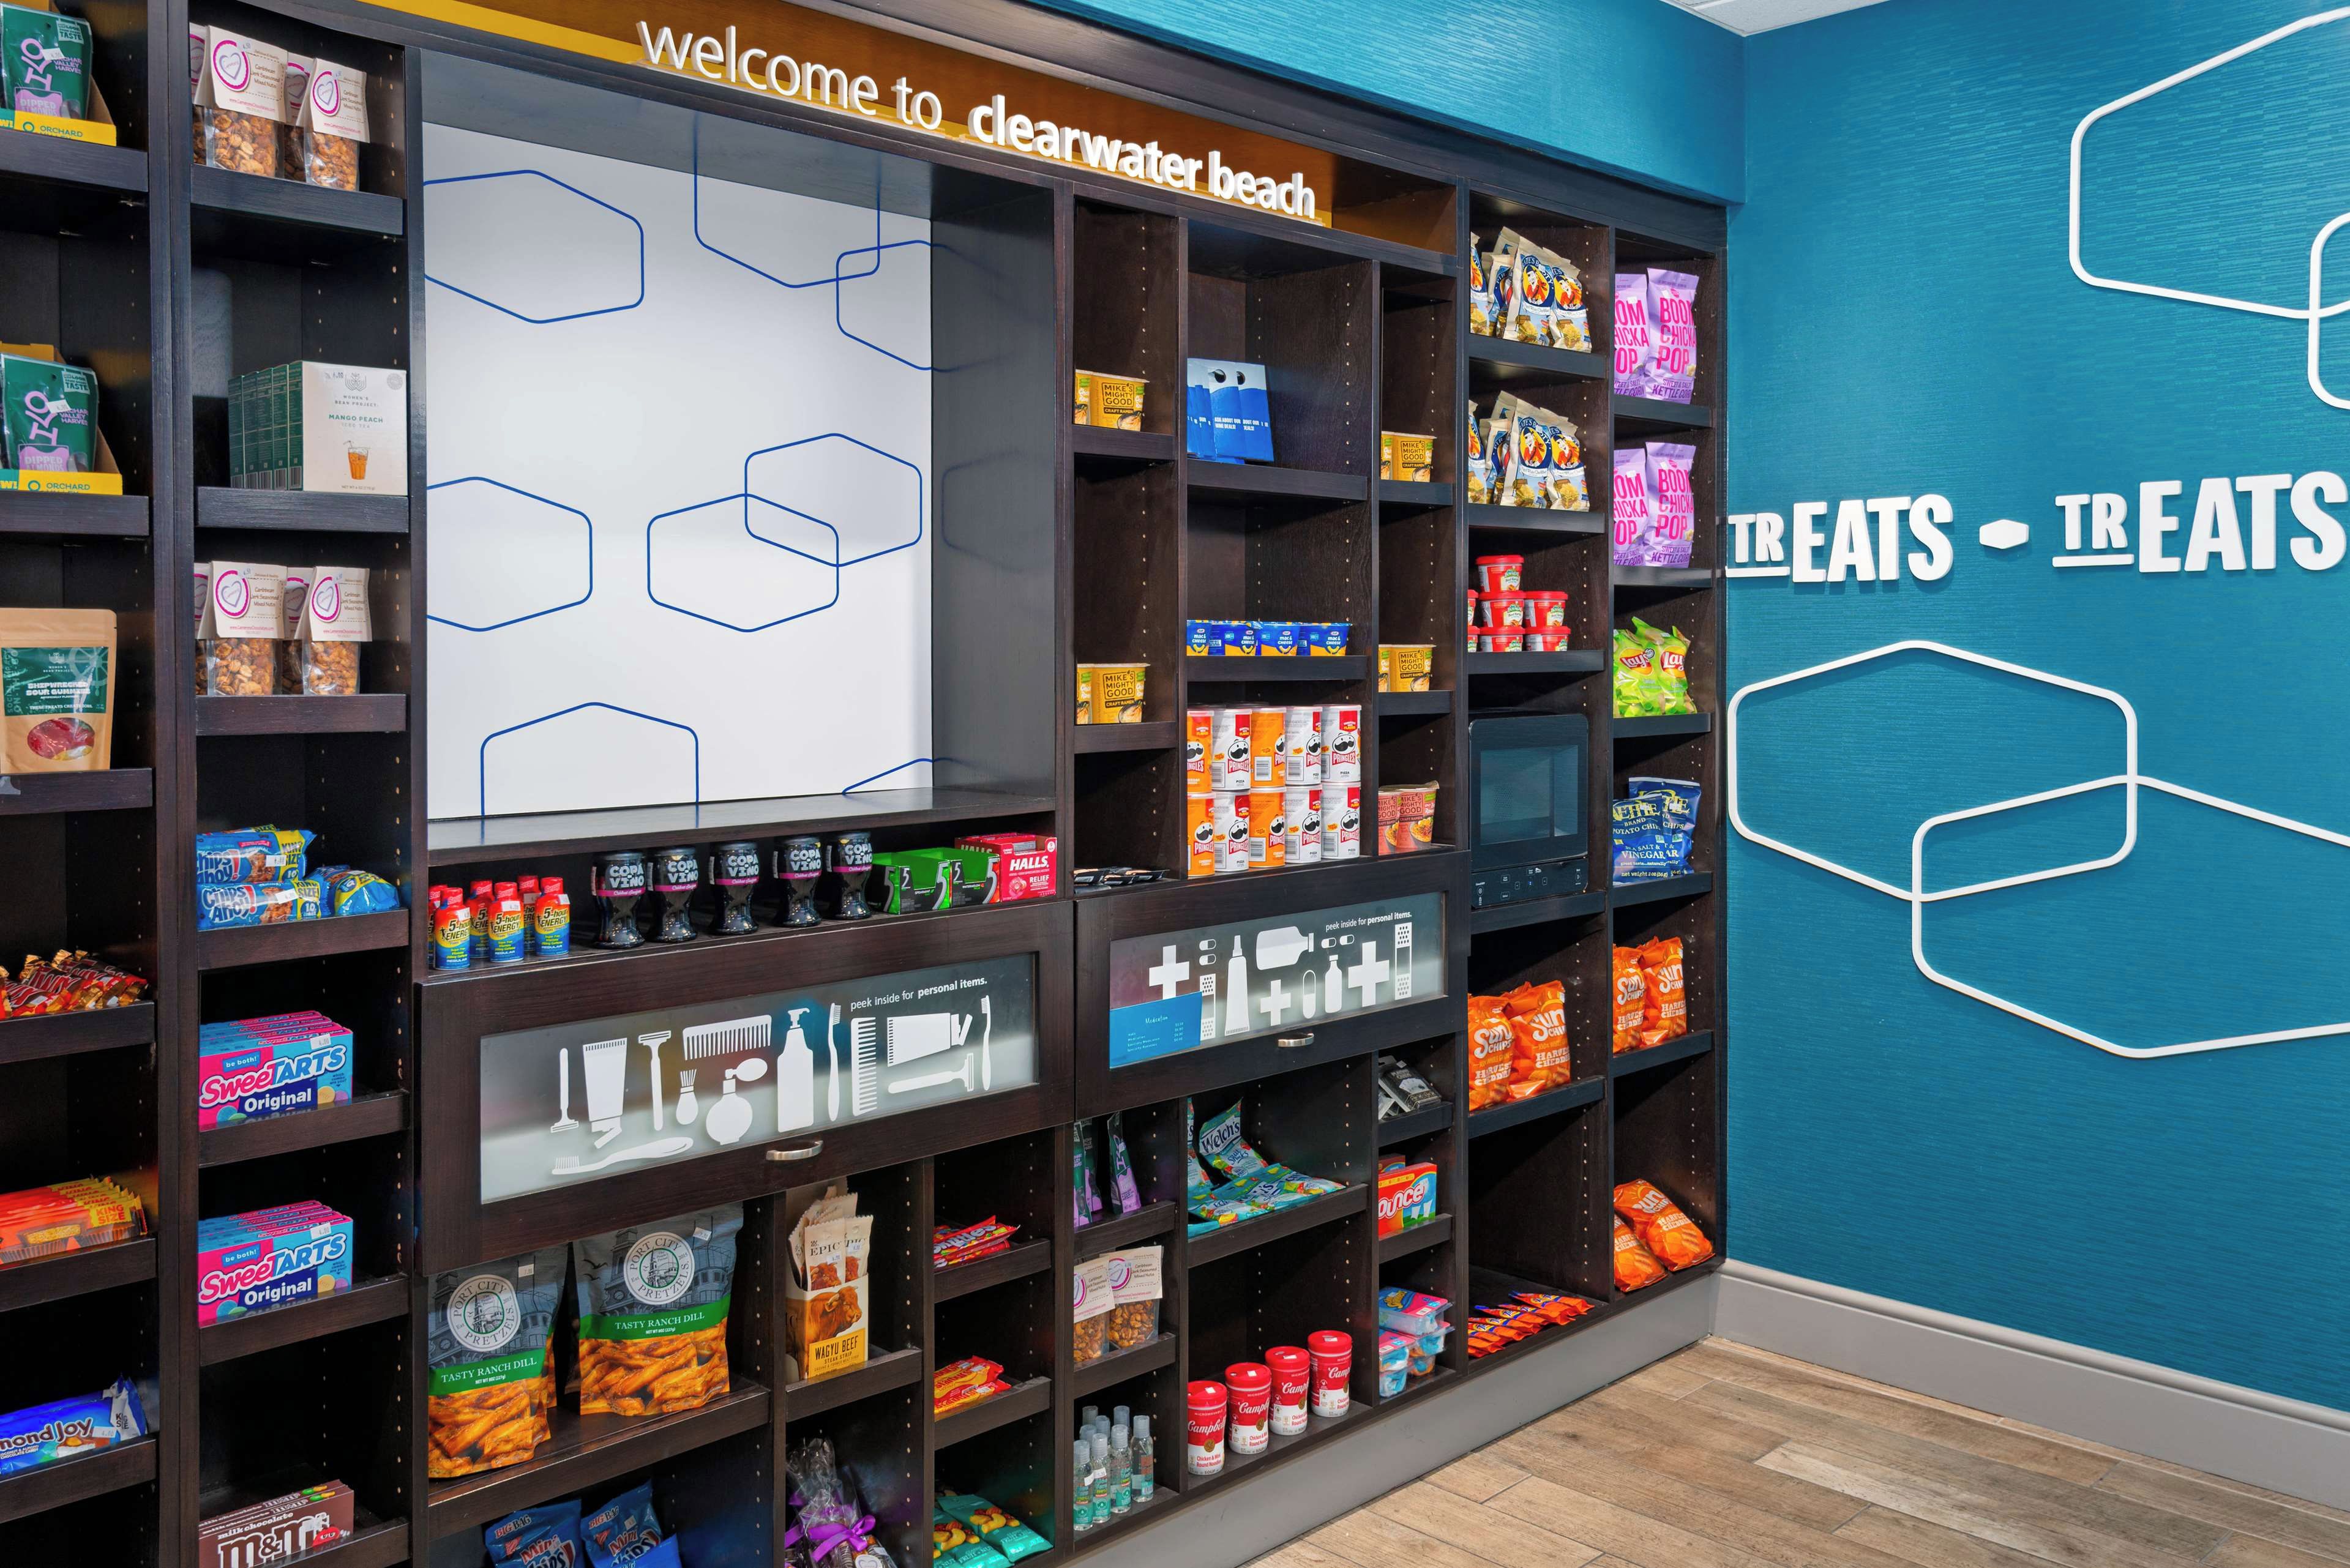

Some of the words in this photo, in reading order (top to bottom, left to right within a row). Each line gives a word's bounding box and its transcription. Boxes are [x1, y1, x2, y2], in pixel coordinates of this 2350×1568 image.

[59, 31, 83, 41] TASTE
[20, 99, 56, 109] DIPPED
[636, 20, 878, 116] welcome
[891, 77, 942, 130] to
[968, 94, 1202, 191] clearwater
[1208, 150, 1315, 219] beach
[40, 125, 83, 138] ORCHARD
[1656, 346, 1690, 374] POP
[65, 382, 88, 390] TASTE
[1104, 383, 1132, 392] MIKE'S
[1663, 379, 1679, 388] SWEET
[1630, 385, 1645, 396] CORN
[1652, 385, 1677, 397] KETTLE
[24, 455, 63, 465] DIPPED
[1655, 515, 1688, 540] POP
[2054, 470, 2349, 573] TREATS
[1727, 493, 1954, 583] TREATS
[1661, 545, 1678, 553] SWEET
[1629, 553, 1644, 565] CORN
[1652, 551, 1676, 562] KETTLE
[1401, 649, 1423, 659] MIKE'S
[1105, 670, 1134, 682] MIKE'S
[1106, 681, 1134, 689] MIGHTY
[1107, 688, 1134, 698] GOOD
[1333, 752, 1355, 764] PRINGLES
[1229, 760, 1249, 773] PRINGLES
[1401, 793, 1421, 802] MIKE'S
[1624, 818, 1646, 826] BRAND
[845, 842, 872, 855] COPA
[1229, 840, 1249, 853] PRINGLES
[727, 854, 758, 867] COPA
[791, 848, 820, 862] COPA
[845, 853, 873, 865] VINO
[1622, 851, 1666, 859] VINEGAR
[610, 864, 644, 876] COPA
[667, 859, 698, 872] COPA
[791, 859, 821, 872] VINO
[1009, 855, 1048, 872] HALLS
[668, 870, 699, 883] VINO
[728, 864, 759, 877] VINO
[610, 876, 644, 888] VINO
[1029, 875, 1049, 883] RELIEF
[203, 886, 246, 908] Chips
[496, 913, 520, 925] 5-hour
[544, 907, 567, 919] 5-hour
[493, 920, 520, 933] ENERGY
[541, 916, 567, 928] ENERGY
[1325, 922, 1340, 932] peek
[1341, 919, 1358, 929] inside
[1358, 917, 1367, 926] for
[1367, 914, 1393, 925] personal
[1394, 911, 1412, 920] items.
[1656, 965, 1683, 994] Sun
[850, 995, 872, 1012] peek
[875, 993, 900, 1006] inside
[902, 990, 914, 1000] for
[918, 982, 958, 999] personal
[960, 977, 987, 989] items.
[1617, 976, 1645, 1005] Sun
[1626, 990, 1644, 1001] CHIPS
[1530, 1009, 1565, 1042] Sun
[1474, 1025, 1512, 1059] Sun
[1488, 1040, 1512, 1053] CHIPS
[237, 1058, 257, 1066] both!
[244, 1088, 312, 1113] Original
[1202, 1121, 1240, 1154] Welch's
[1378, 1183, 1425, 1218] ounce
[96, 1204, 124, 1216] KING
[98, 1212, 125, 1225] SIZE
[237, 1250, 257, 1260] both!
[630, 1241, 650, 1270] PORT
[655, 1238, 682, 1252] CITY
[810, 1241, 841, 1256] EPIC
[244, 1278, 312, 1305] Original
[454, 1286, 474, 1317] PORT
[478, 1280, 507, 1293] CITY
[615, 1320, 646, 1330] TASTY
[648, 1316, 681, 1327] RANCH
[683, 1312, 705, 1323] DILL
[815, 1342, 839, 1361] WAGYU
[842, 1335, 859, 1353] BEEF
[825, 1356, 838, 1365] STEAK
[839, 1352, 852, 1361] STRIP
[441, 1369, 476, 1383] TASTY
[477, 1362, 512, 1377] RANCH
[514, 1357, 537, 1370] DILL
[55, 1417, 93, 1443] Joy
[589, 1515, 604, 1528] BIG
[604, 1506, 619, 1521] BAG
[217, 1527, 244, 1540] milk
[244, 1512, 294, 1531] chocolate
[495, 1524, 512, 1538] BIG
[512, 1515, 532, 1529] BAG
[608, 1527, 640, 1556] Mini
[522, 1534, 559, 1564] Mini
